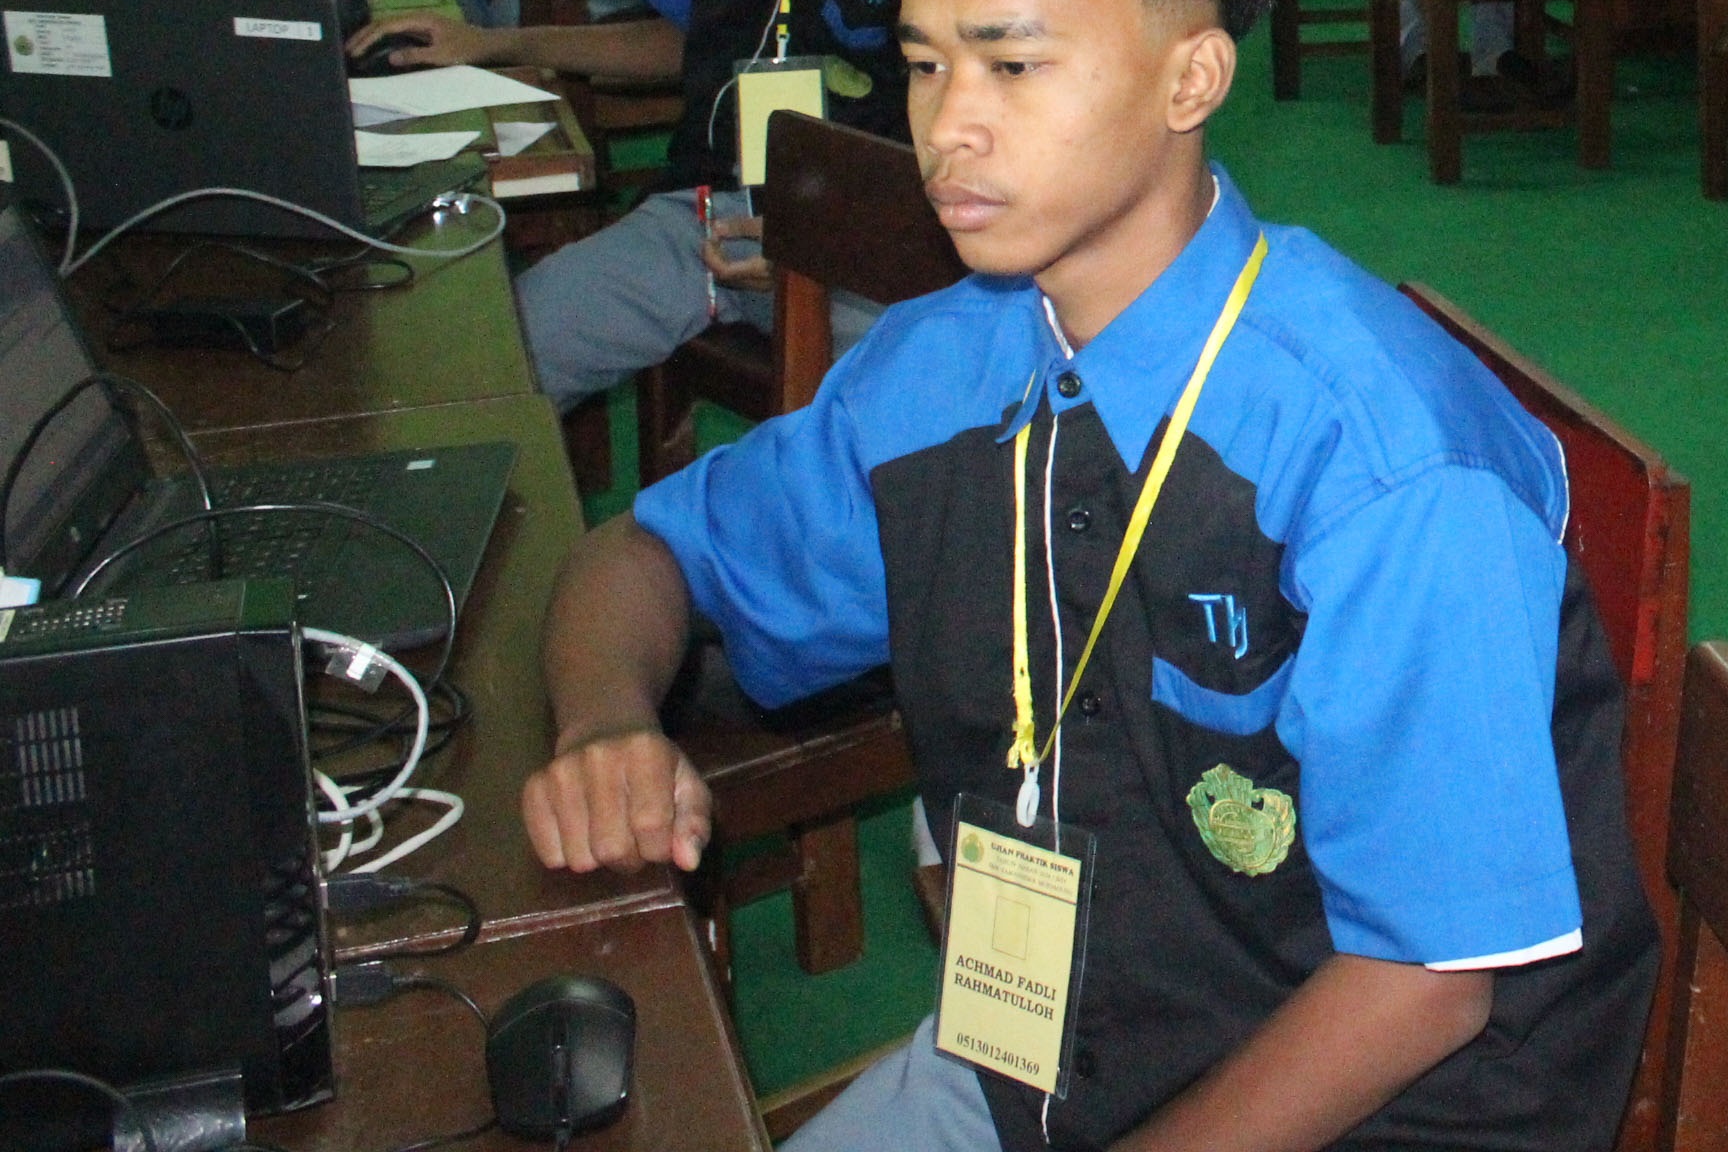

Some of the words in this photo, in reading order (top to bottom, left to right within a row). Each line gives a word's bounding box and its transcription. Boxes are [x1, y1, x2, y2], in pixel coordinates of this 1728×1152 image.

[245, 22, 289, 35] LAPTOP
[953, 972, 1055, 1022] RAHMATULLOH
[955, 954, 1014, 985] ACHMAD
[1017, 975, 1057, 1001] FADLI
[956, 1031, 1040, 1076] 0513012401369
